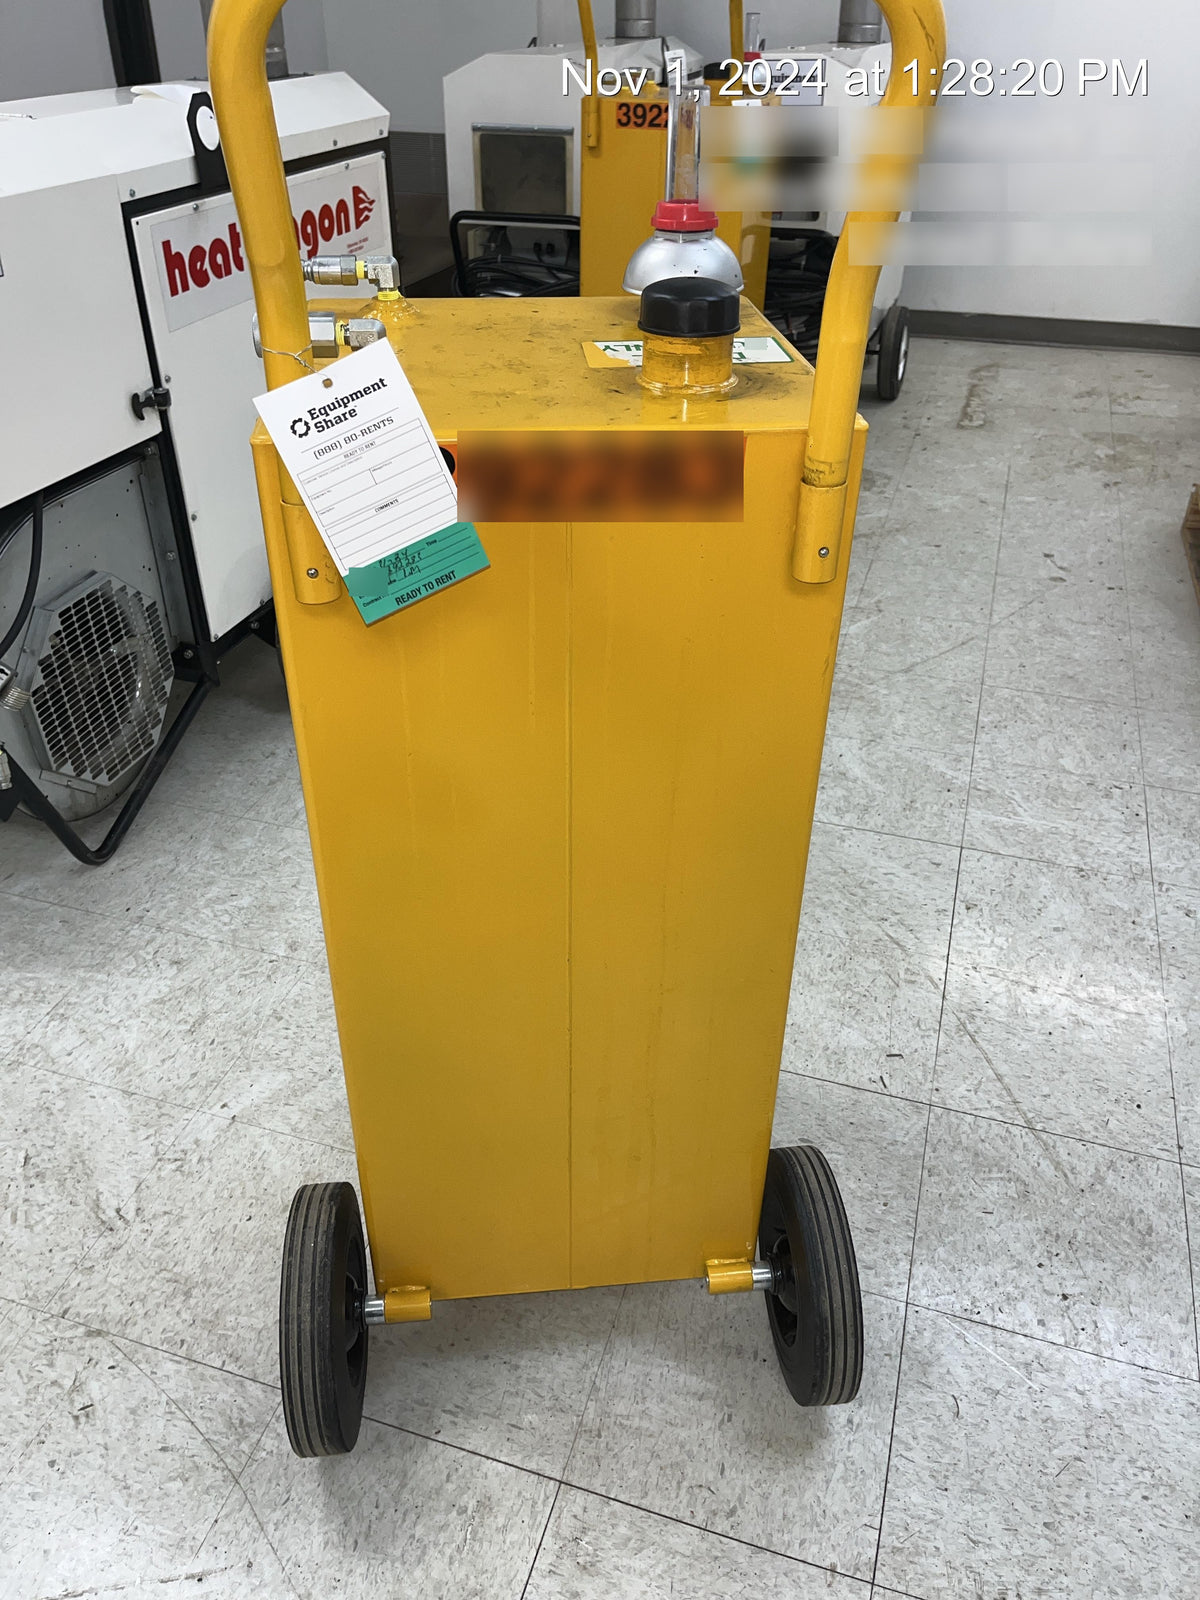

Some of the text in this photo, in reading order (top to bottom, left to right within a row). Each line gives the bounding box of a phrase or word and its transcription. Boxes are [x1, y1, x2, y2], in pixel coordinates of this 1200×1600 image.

[617, 102, 669, 128] 392
[161, 222, 245, 297] heat
[306, 377, 388, 421] Equipment
[313, 416, 394, 460] (888) 80-RENTS
[374, 498, 399, 513] COMMENTS
[395, 569, 457, 606] READY TO RENT
